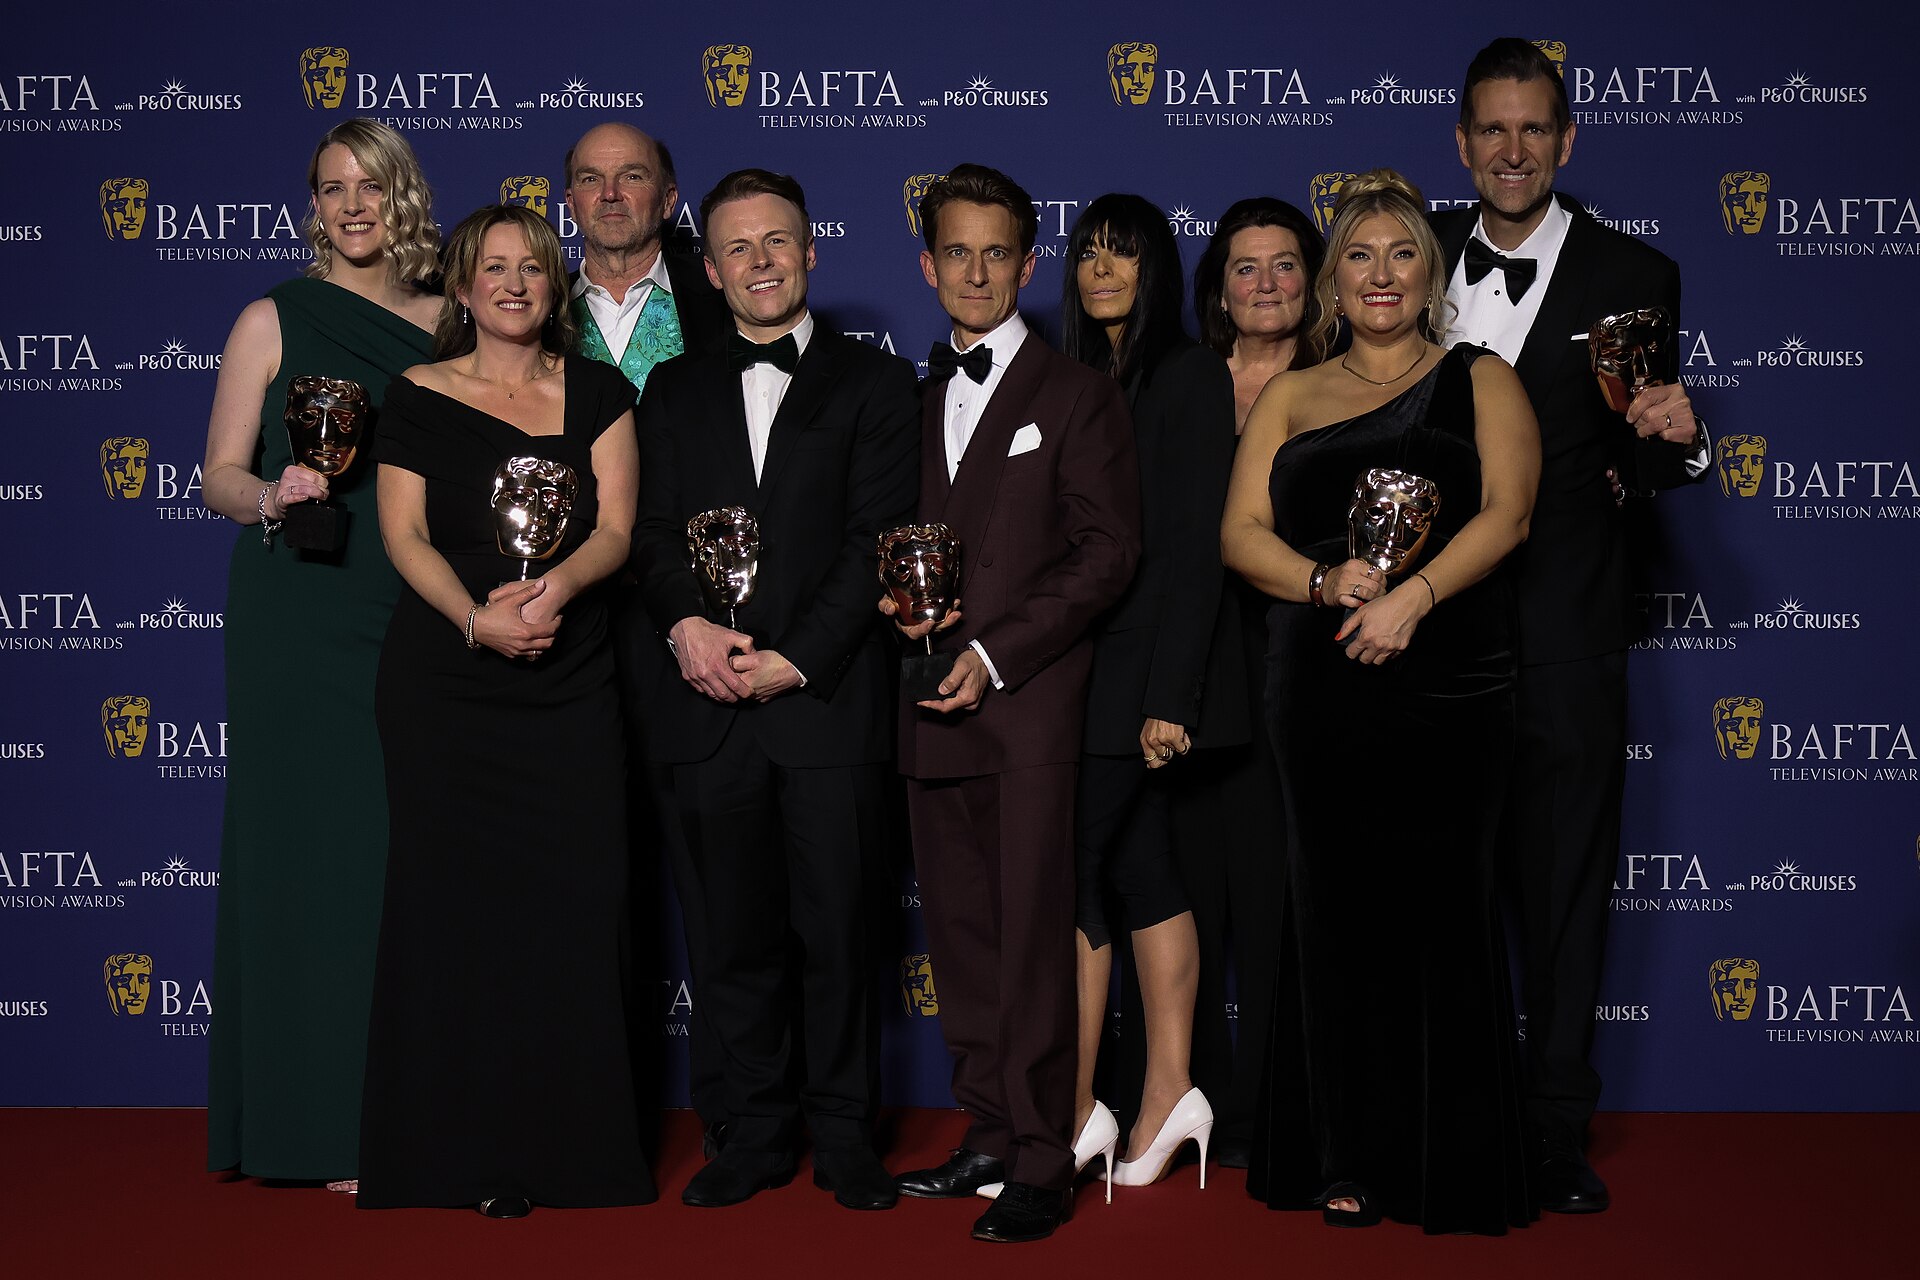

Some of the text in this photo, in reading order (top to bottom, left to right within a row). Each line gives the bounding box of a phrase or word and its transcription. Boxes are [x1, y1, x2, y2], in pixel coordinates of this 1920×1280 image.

[357, 73, 500, 108] BAFTA
[541, 93, 572, 108] P&O
[578, 93, 643, 108] CRUISES
[759, 71, 904, 106] BAFTA
[944, 91, 977, 106] P&O
[982, 91, 1048, 106] CRUISES
[1165, 69, 1310, 105] BAFTA
[1352, 89, 1384, 104] P&O
[1390, 89, 1456, 104] CRUISES
[1574, 67, 1720, 103] BAFTA
[1762, 87, 1794, 102] P&O
[1800, 87, 1866, 102] CRUISES
[139, 95, 171, 110] P&O
[177, 95, 241, 110] CRUISES
[57, 119, 121, 131] AWARDS
[368, 117, 522, 130] EVISION AWARDS
[759, 115, 926, 127] TELEVISION AWARDS
[1164, 113, 1332, 125] TELEVISION AWARDS
[1573, 112, 1742, 124] TELEVISION AWARDS
[156, 204, 299, 239] BAFTA
[1777, 198, 1920, 234] BAFTA
[0, 226, 41, 241] UISES
[810, 222, 845, 237] ISES
[156, 248, 316, 260] TELEVISION AWARD
[1777, 243, 1874, 255] TELEVISION
[140, 354, 171, 369] P&O
[1758, 351, 1791, 366] P&O
[1797, 351, 1863, 366] CRUISES
[58, 378, 121, 390] AWARDS
[1774, 462, 1920, 497] BAFTA
[0, 485, 42, 500] UISES
[157, 507, 226, 519] TELEVI
[1773, 506, 1870, 518] TELEVISION
[141, 613, 172, 628] P&O
[178, 613, 223, 628] CRUIS
[1755, 613, 1787, 628] P&O
[1793, 613, 1860, 628] CRUISES
[59, 637, 122, 649] AWARDS
[1670, 637, 1736, 649] AWARDS
[1770, 724, 1917, 759] BAFTA
[0, 744, 44, 758] UISES
[158, 766, 226, 778] TELEVISI
[1770, 768, 1918, 780] TELEVISION AWAR
[142, 871, 173, 886] P&O
[1613, 855, 1710, 890] FTA
[1751, 875, 1784, 890] P&O
[1790, 875, 1856, 890] CRUISES
[0, 895, 124, 907] VISION AWARDS
[1667, 899, 1732, 911] AWARDS
[1767, 986, 1913, 1021] BAFTA
[1596, 1006, 1649, 1020] RUISES
[161, 1024, 209, 1035] TELEV
[1766, 1030, 1863, 1042] TELEVISION
